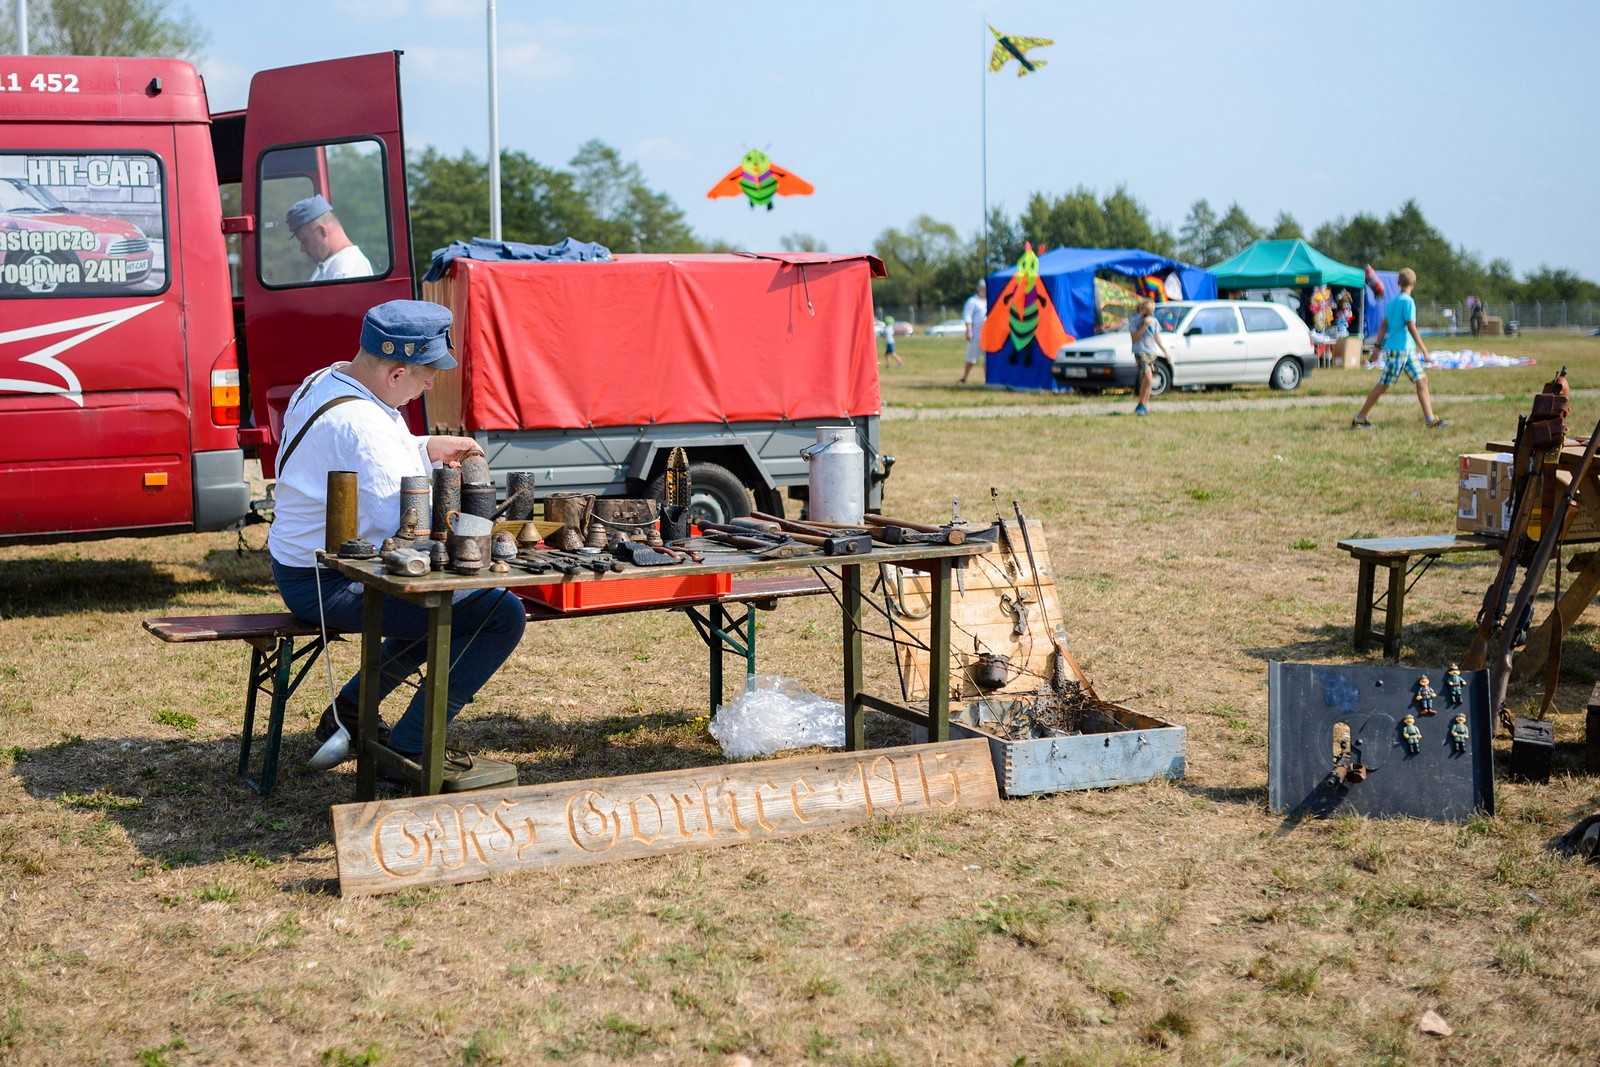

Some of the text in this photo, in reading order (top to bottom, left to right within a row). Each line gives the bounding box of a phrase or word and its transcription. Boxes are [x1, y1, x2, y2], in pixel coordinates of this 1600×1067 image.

[30, 73, 80, 93] 452
[27, 159, 150, 187] HIT-CAR
[84, 258, 127, 283] 24H
[566, 775, 820, 853] Gorlice
[846, 751, 962, 817] 1915
